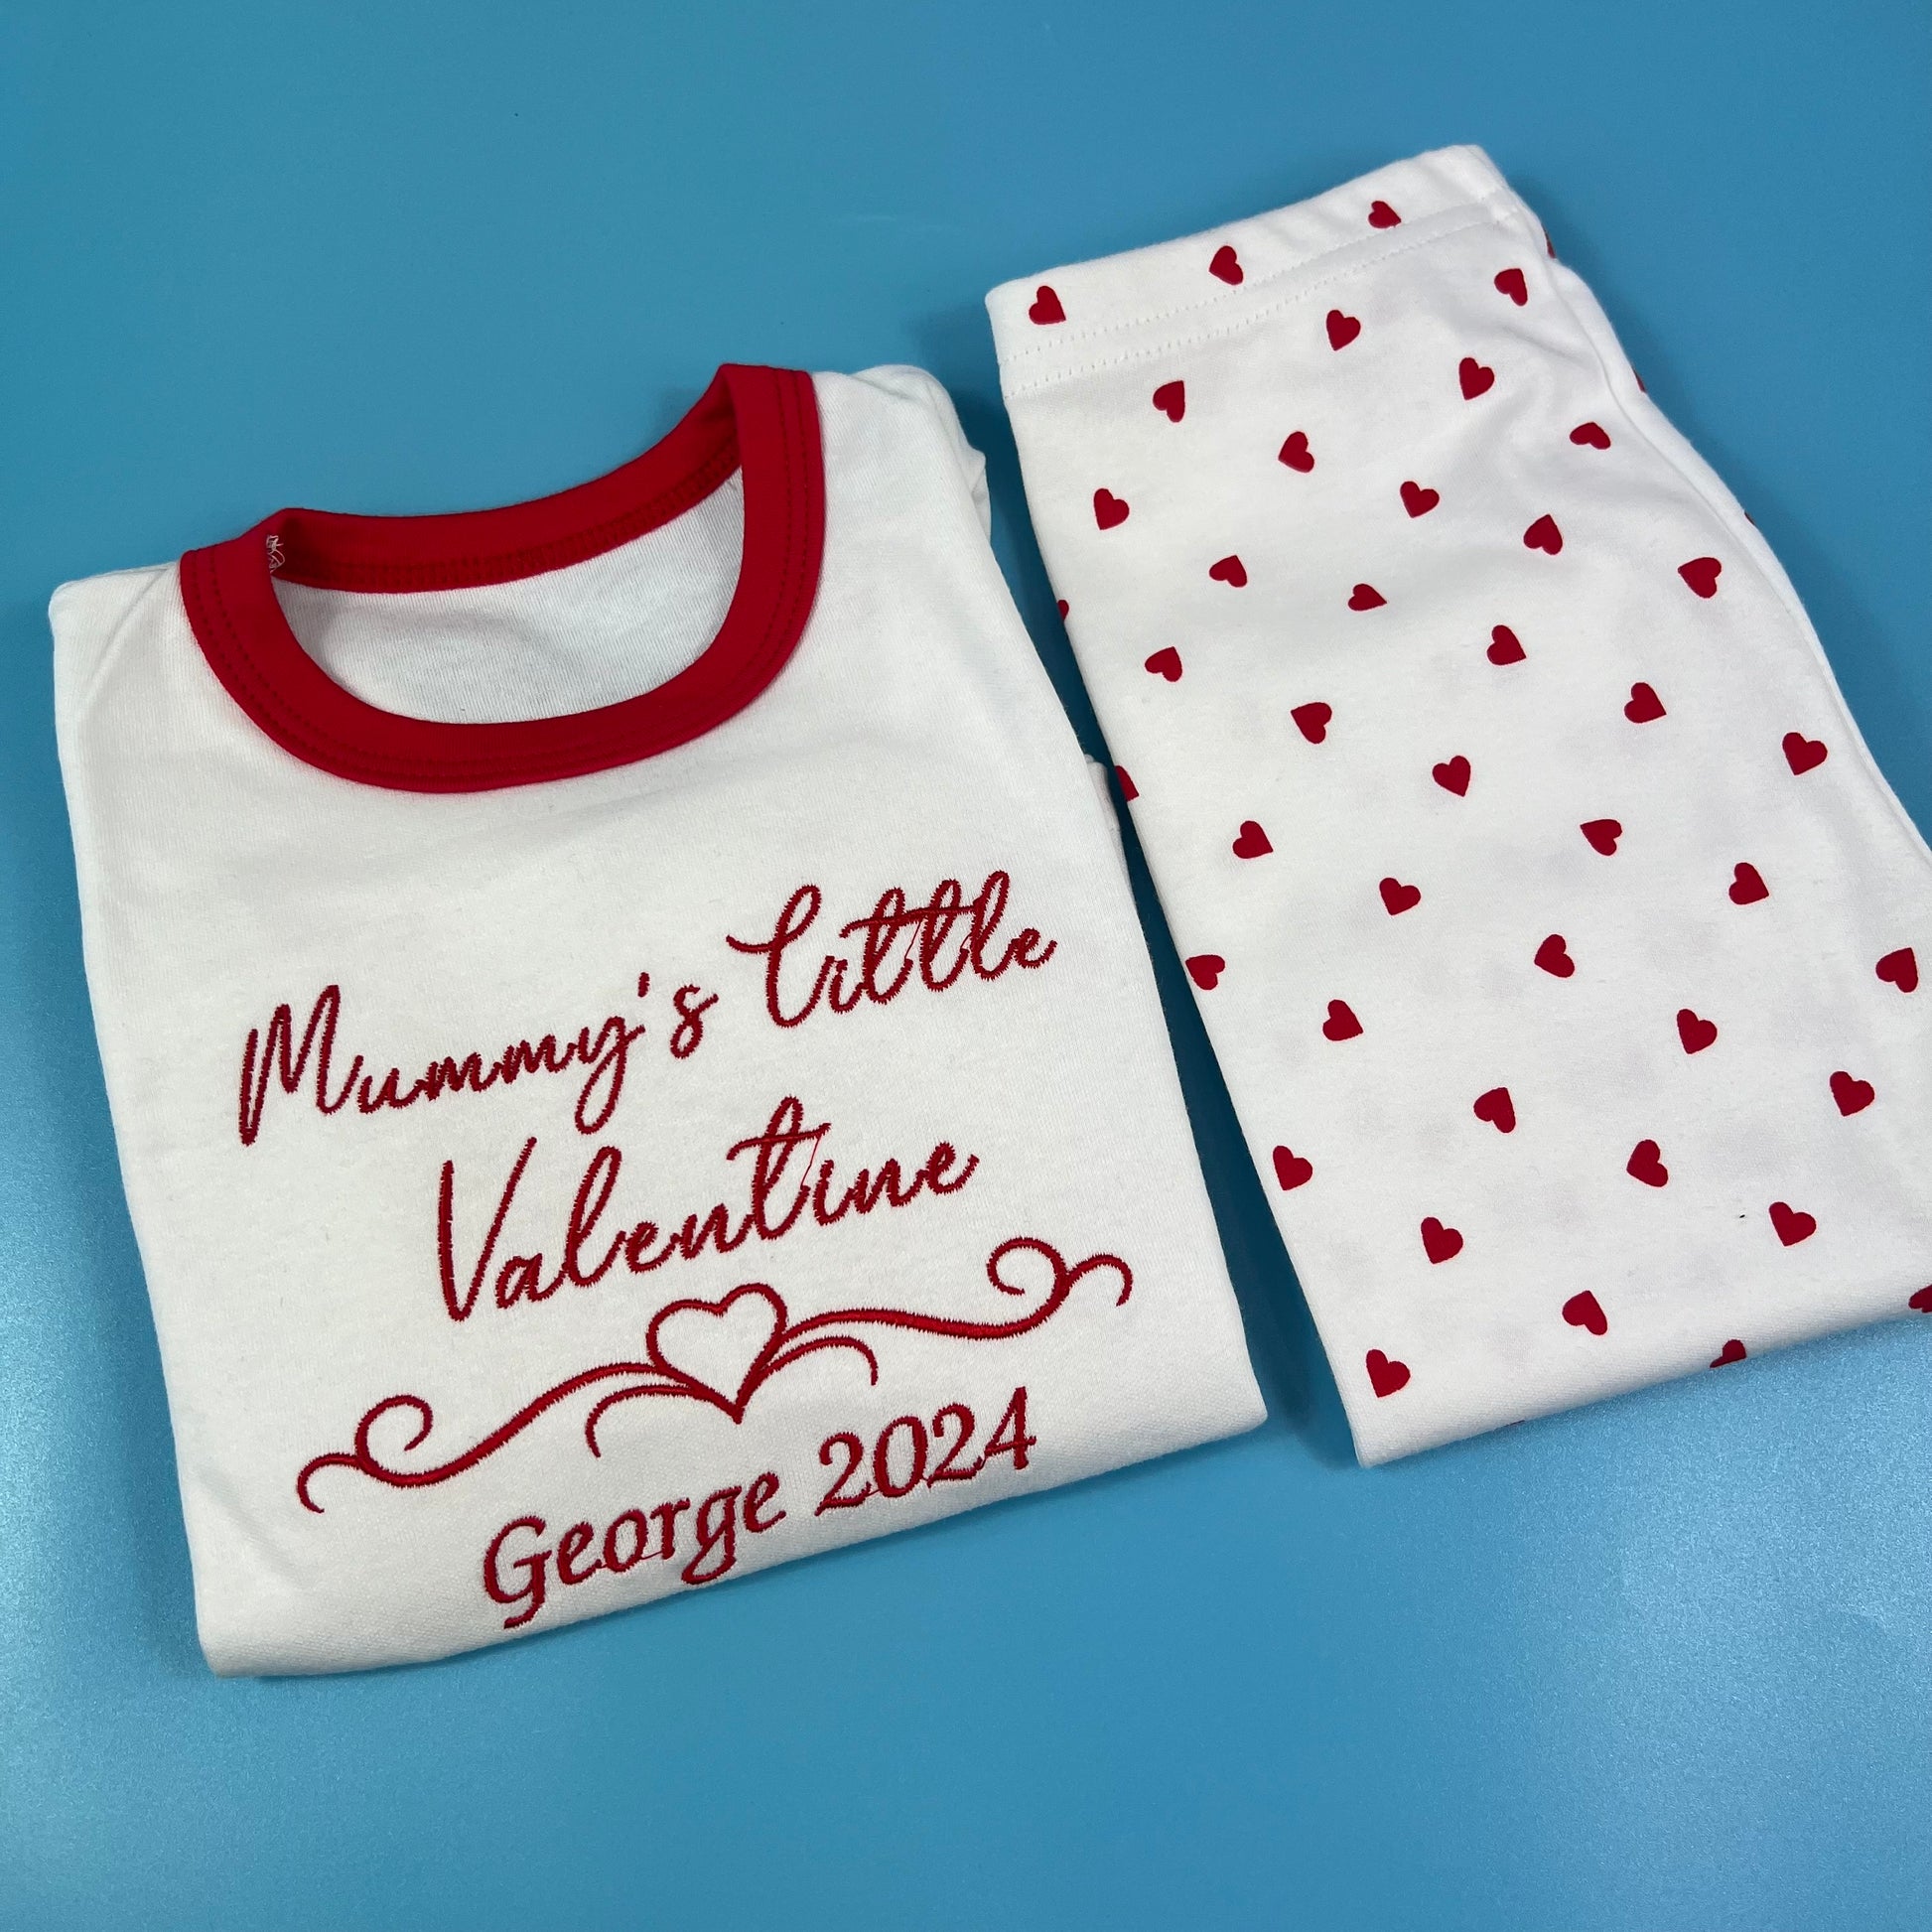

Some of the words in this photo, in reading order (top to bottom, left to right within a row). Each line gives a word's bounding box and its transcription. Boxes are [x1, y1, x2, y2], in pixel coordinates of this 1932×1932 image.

[238, 971, 718, 1146] Mummy's
[437, 1095, 980, 1321] Valentine
[483, 1471, 786, 1629] George
[814, 1386, 1036, 1516] 2024
